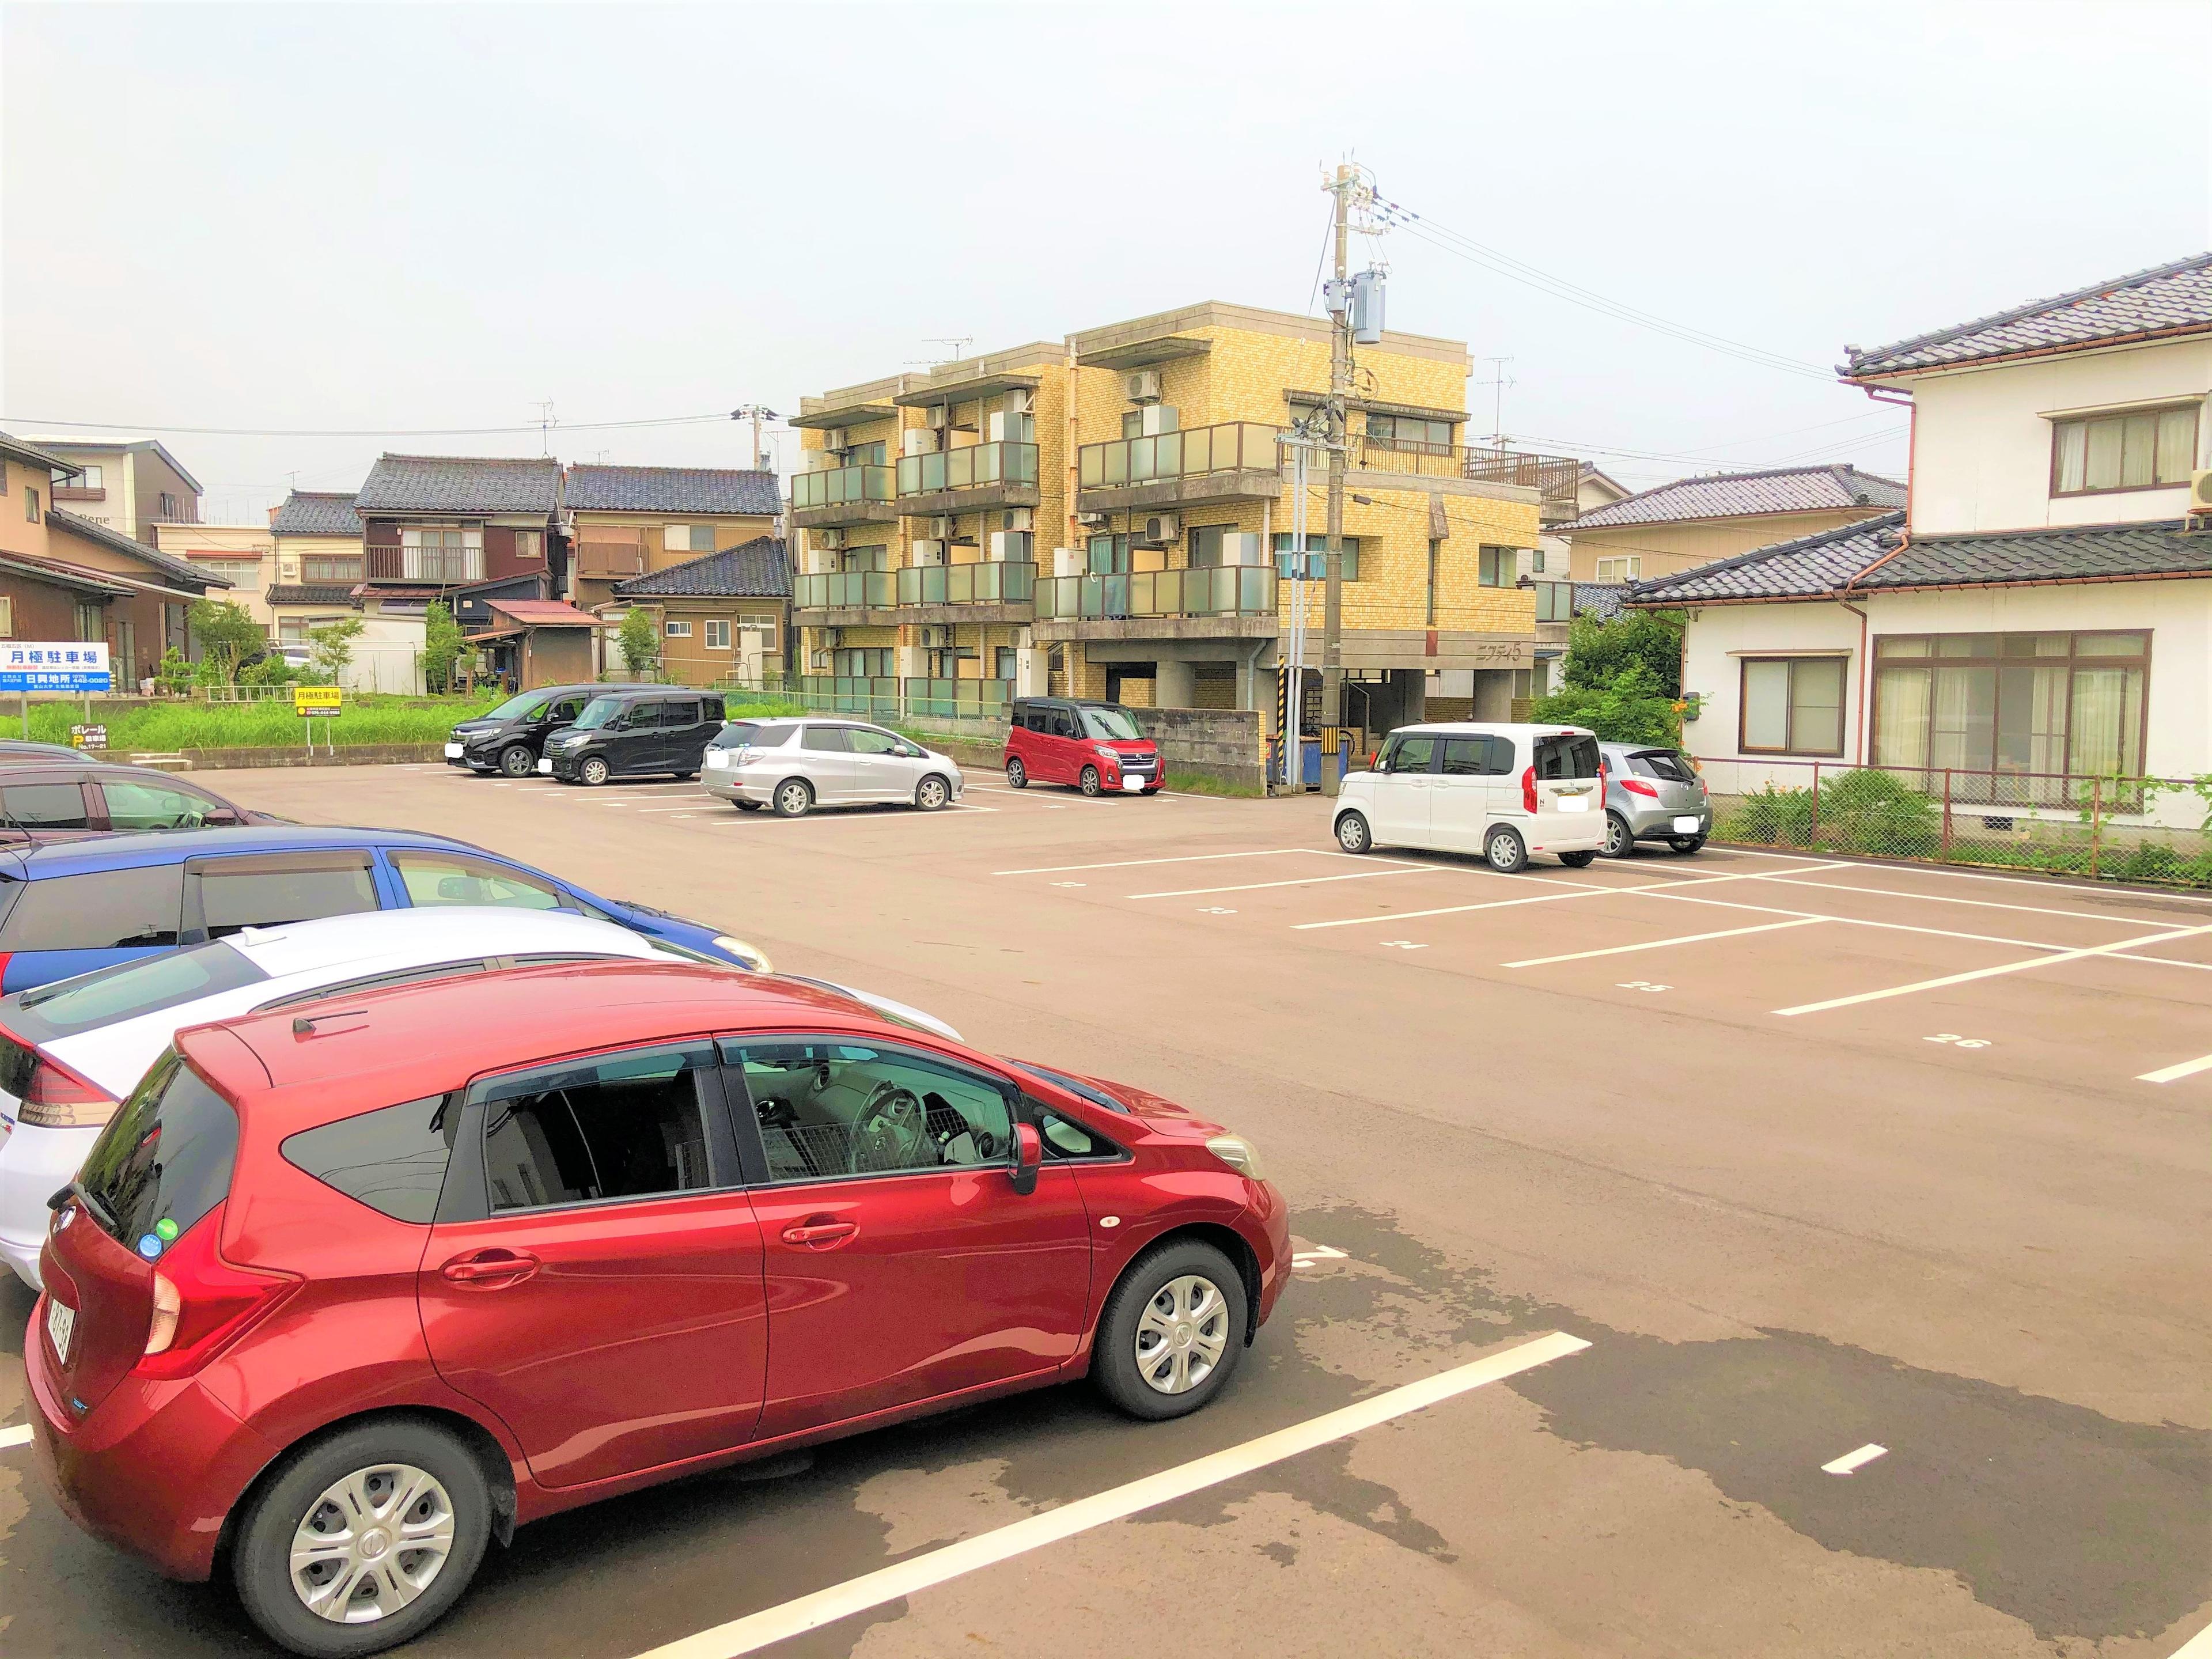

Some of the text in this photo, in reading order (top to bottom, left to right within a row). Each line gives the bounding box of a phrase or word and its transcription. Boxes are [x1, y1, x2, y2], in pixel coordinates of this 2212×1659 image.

[11, 651, 97, 663] 月極駐車場
[26, 674, 70, 684] 日興地所
[298, 691, 339, 699] 月極駐車場
[73, 735, 84, 749] P
[1615, 982, 1674, 991] 25
[1923, 1034, 1991, 1048] 26
